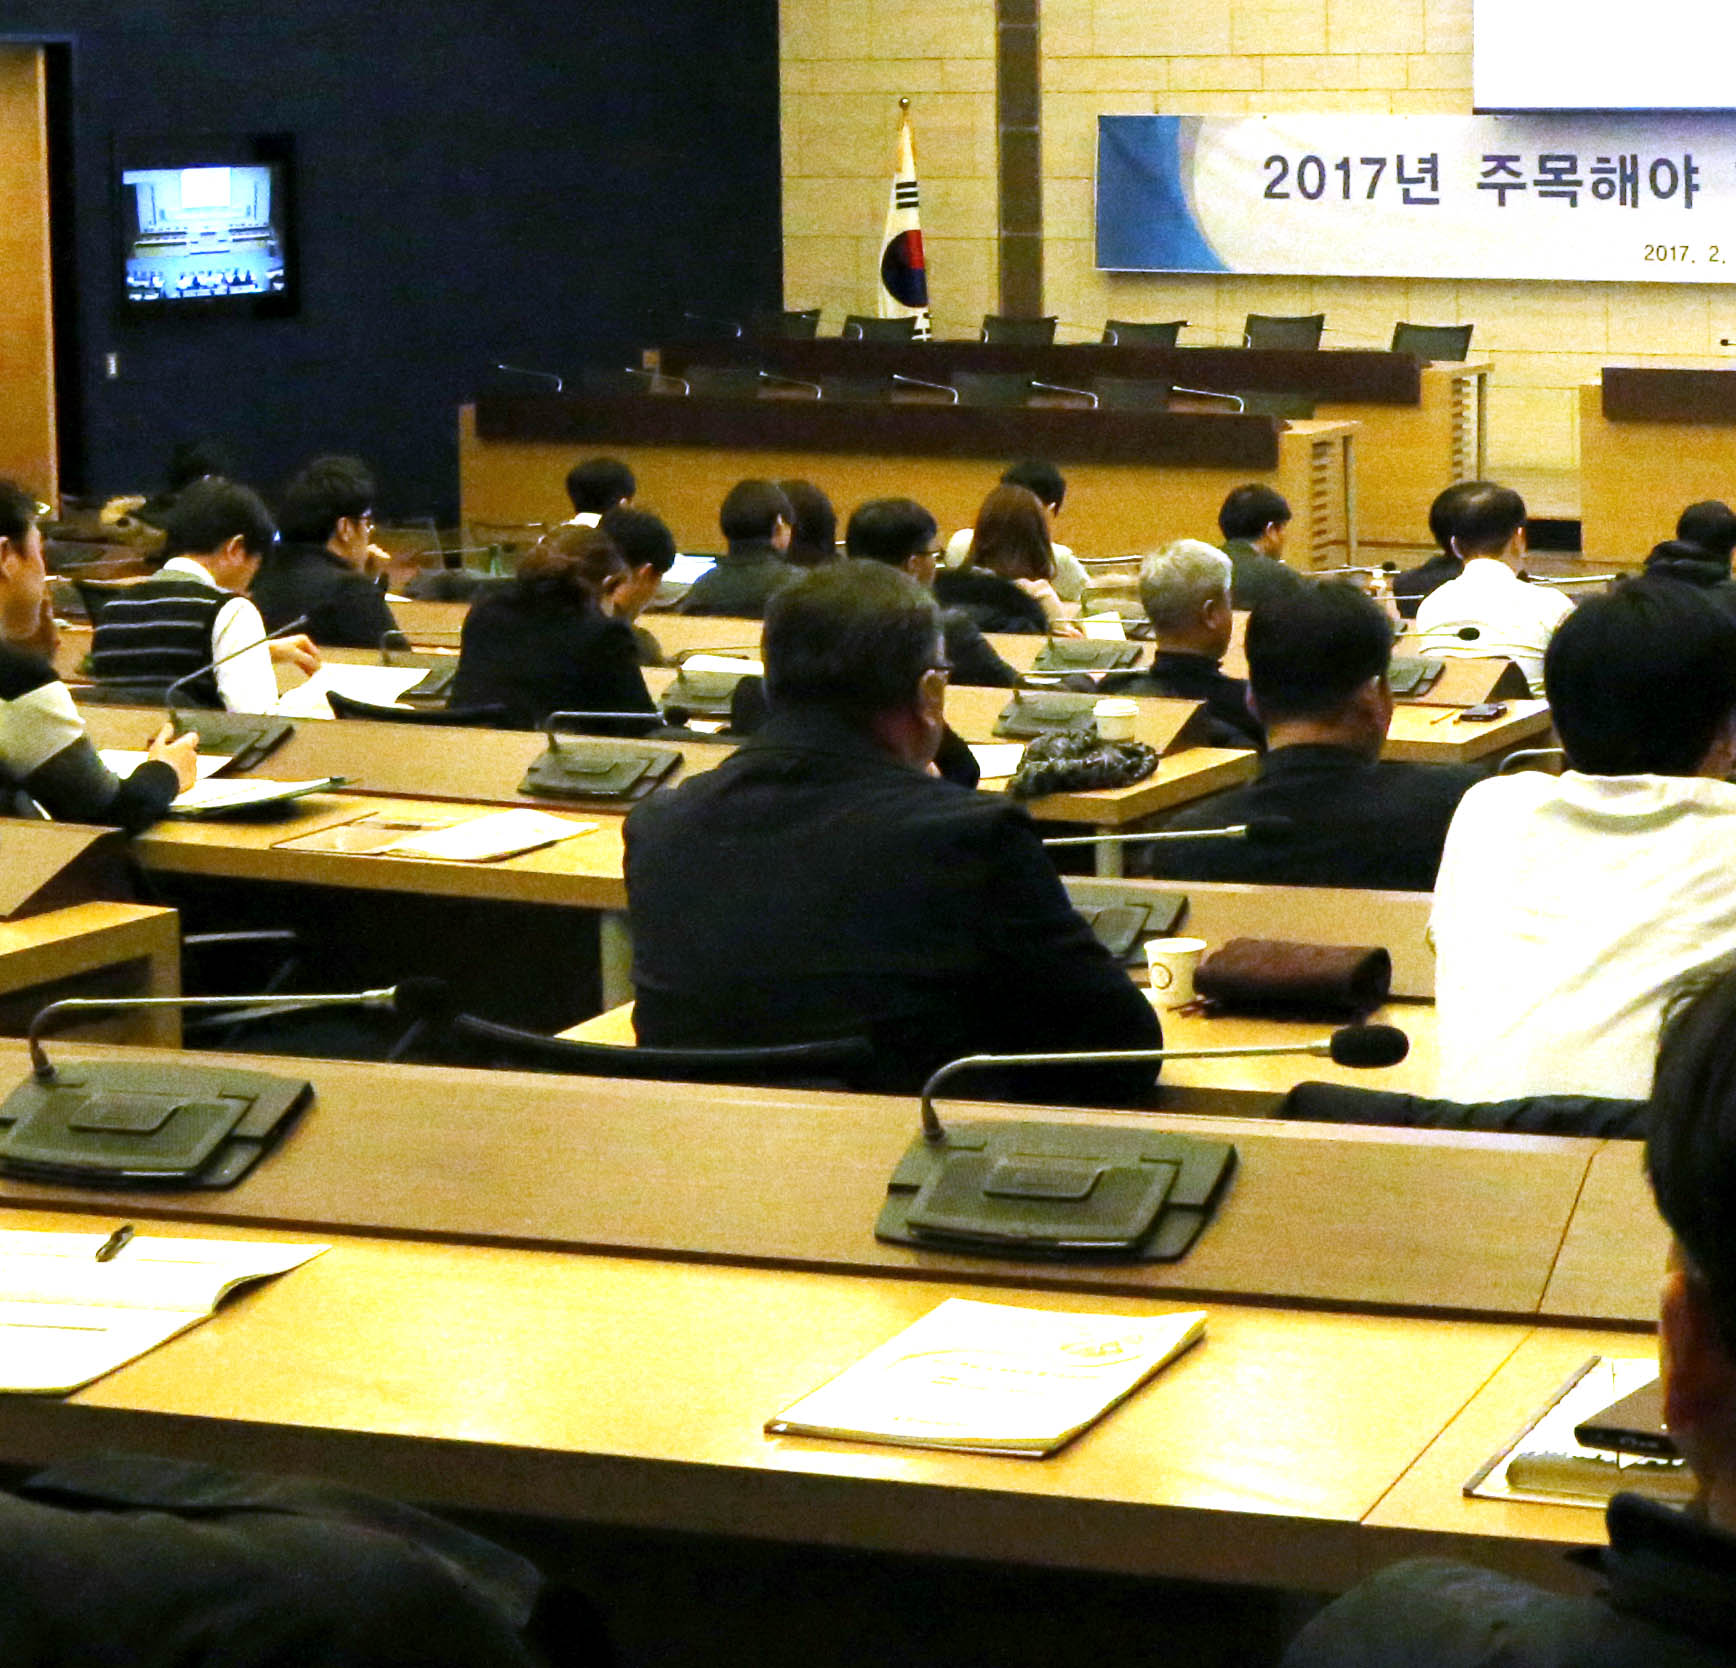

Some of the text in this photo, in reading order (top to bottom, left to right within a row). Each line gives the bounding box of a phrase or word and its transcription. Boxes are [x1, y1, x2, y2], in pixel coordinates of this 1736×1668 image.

[1263, 152, 1440, 205] 2017년
[1476, 153, 1700, 210] 주목해야
[1644, 244, 1696, 264] 2017.
[1708, 245, 1726, 265] 2.
